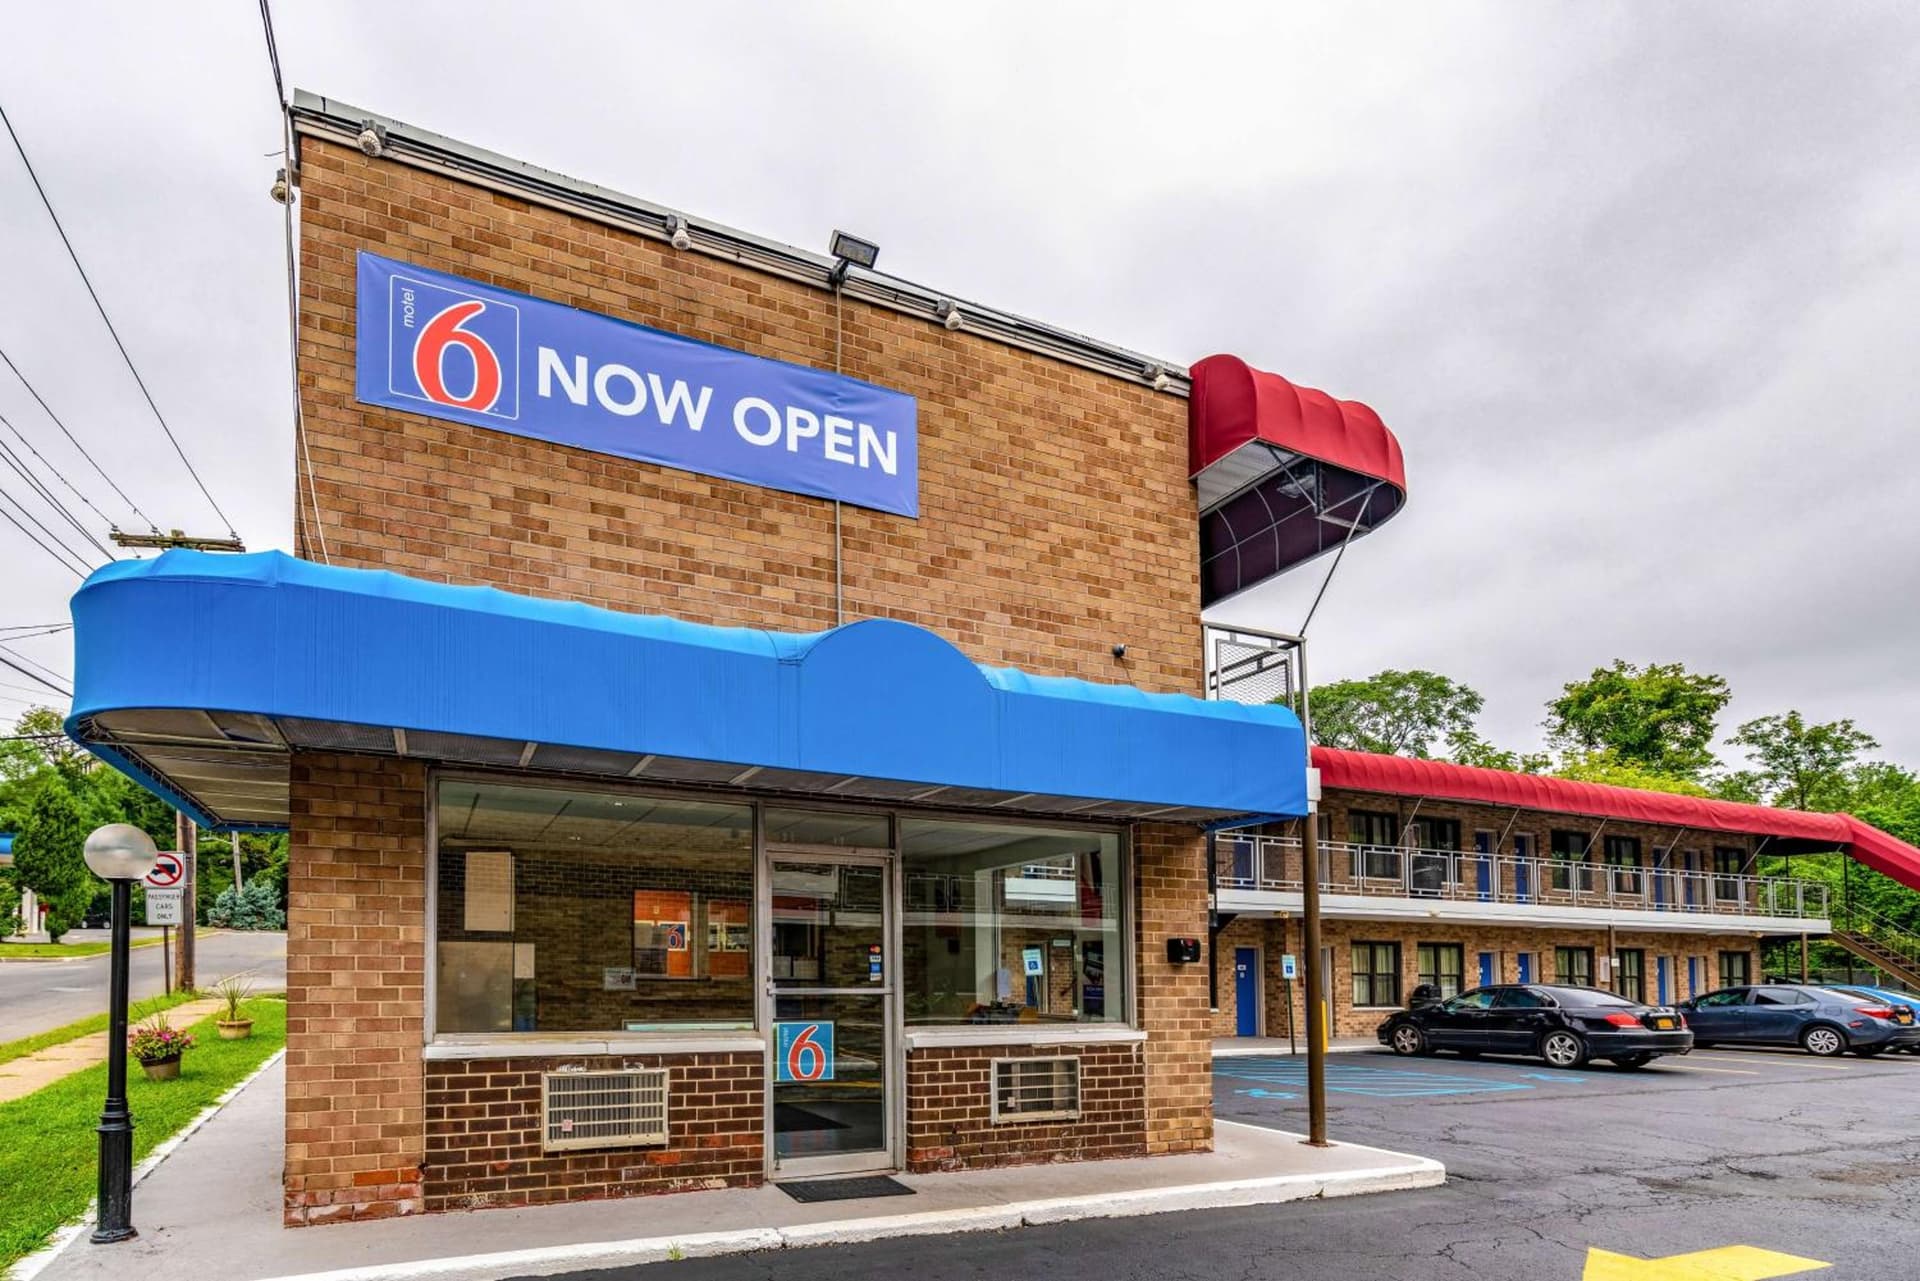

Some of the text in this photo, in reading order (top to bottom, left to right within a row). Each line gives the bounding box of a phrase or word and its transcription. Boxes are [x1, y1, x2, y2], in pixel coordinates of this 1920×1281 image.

[402, 288, 502, 412] motel 6
[538, 346, 897, 476] NOW OPEN
[788, 1024, 826, 1081] 6
